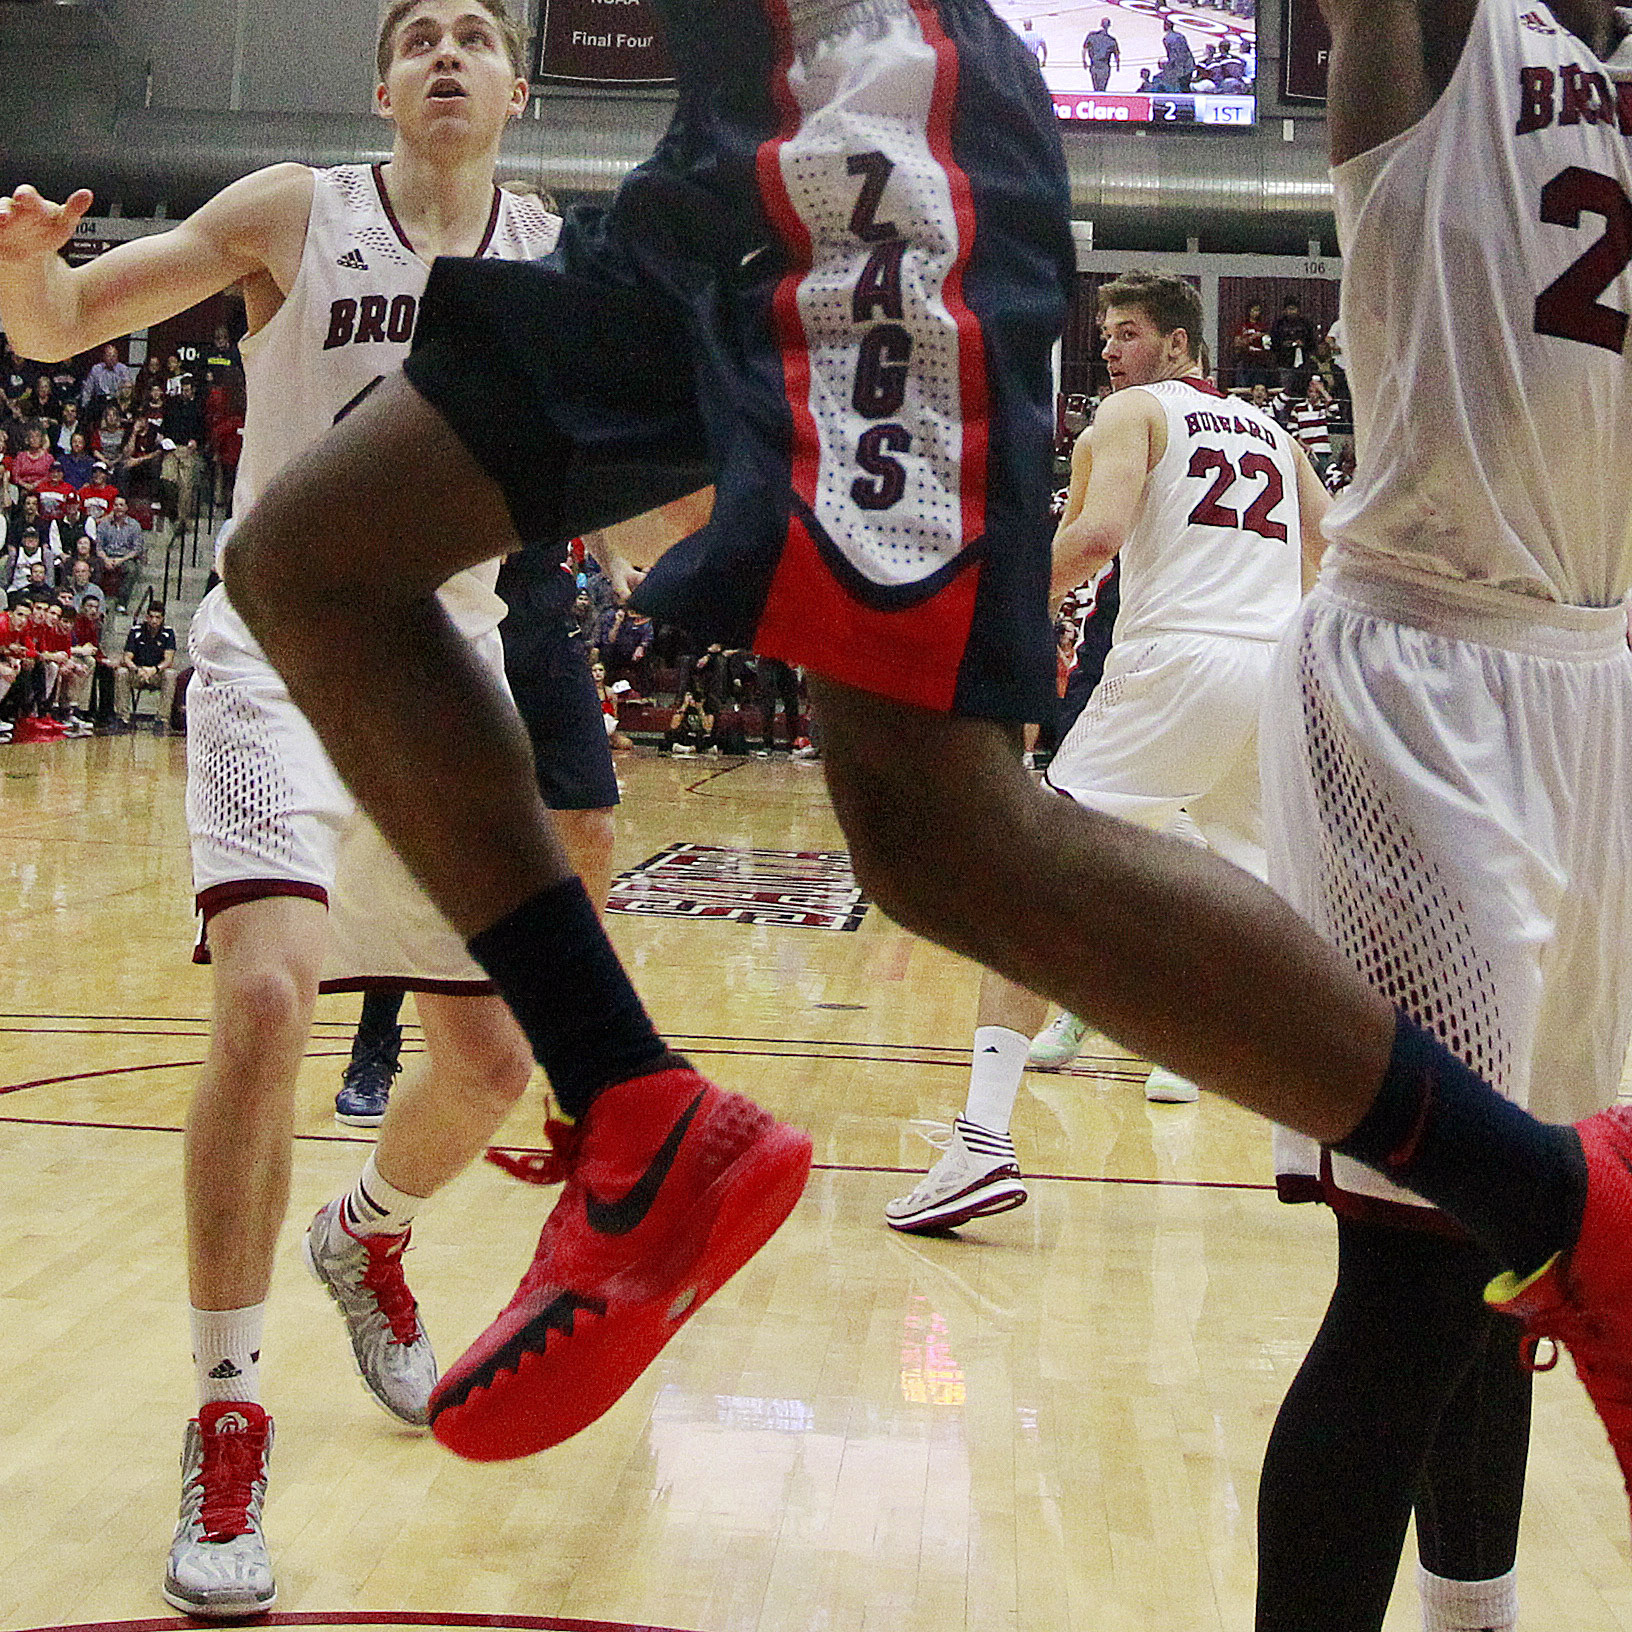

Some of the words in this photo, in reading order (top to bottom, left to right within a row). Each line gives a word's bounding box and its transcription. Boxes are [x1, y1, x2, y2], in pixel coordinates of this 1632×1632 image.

[571, 30, 612, 48] Final
[616, 33, 654, 49] Four
[1075, 100, 1130, 122] Clara
[1164, 101, 1178, 121] 2
[1212, 106, 1244, 123] 1ST
[845, 150, 913, 511] ZAGS
[176, 346, 200, 361] 10
[1186, 446, 1288, 544] 22
